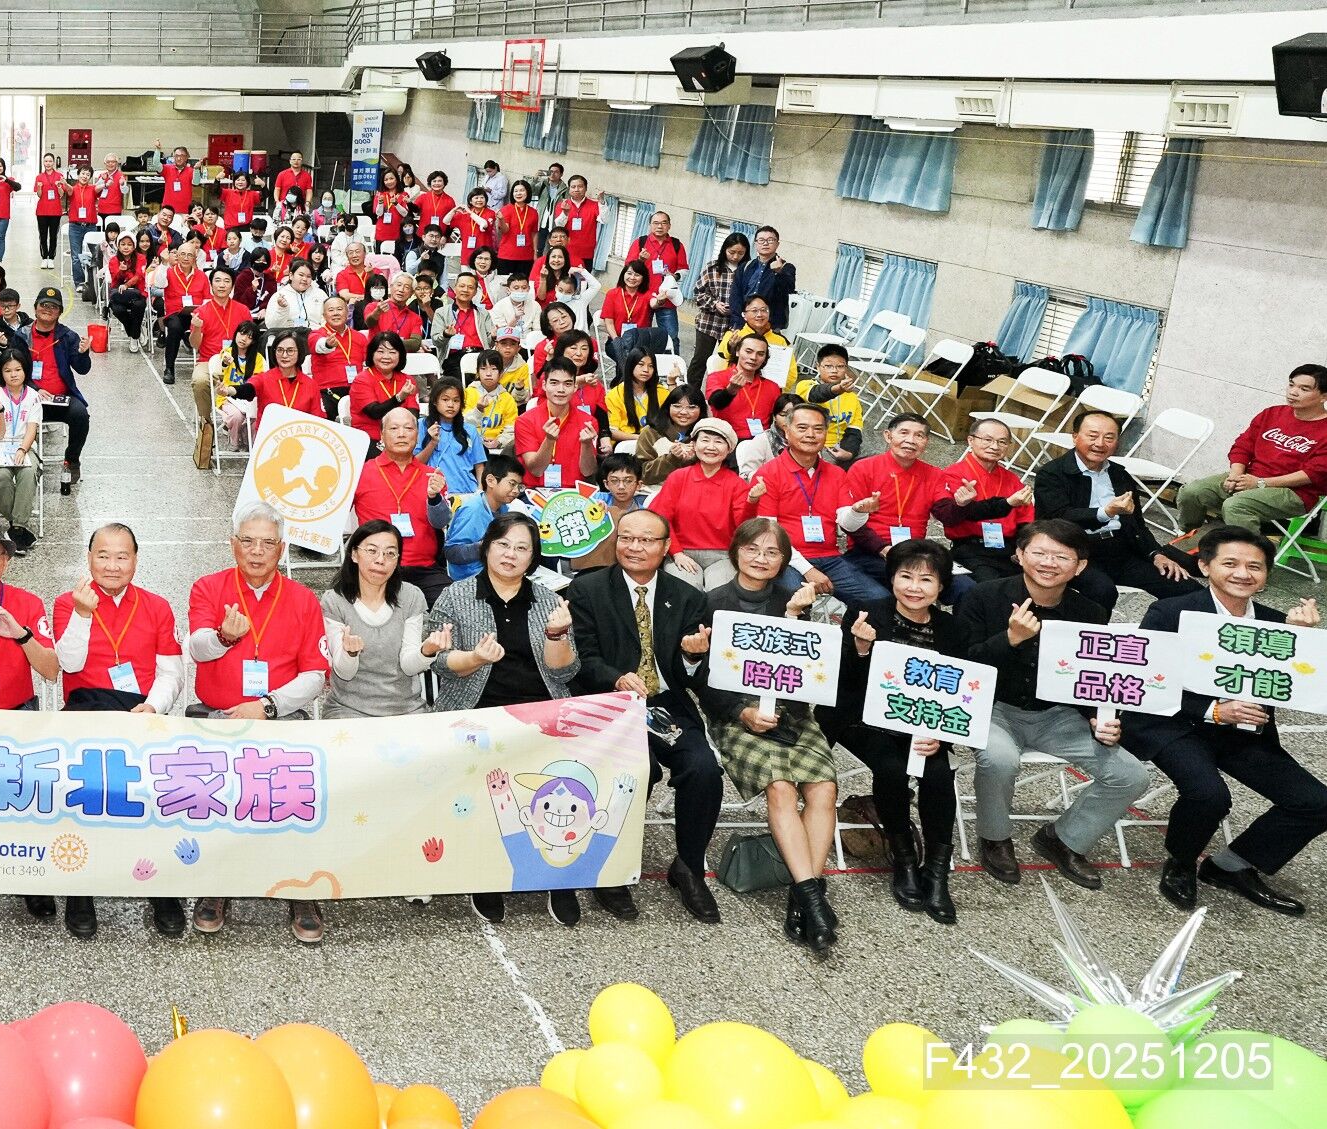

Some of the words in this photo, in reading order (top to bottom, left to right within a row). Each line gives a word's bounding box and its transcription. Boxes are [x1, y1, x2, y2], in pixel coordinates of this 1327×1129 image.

[273, 425, 320, 444] ROTARY
[322, 431, 348, 463] D3490
[287, 526, 333, 547] 新北家族
[732, 623, 822, 660] 家族式
[1076, 630, 1150, 666] 正直
[1217, 622, 1297, 661] 領導
[742, 660, 803, 694] 陪伴
[904, 656, 964, 695] 教育
[1073, 670, 1147, 706] 品格
[1214, 664, 1293, 702] 才能
[884, 692, 973, 737] 支持金
[18, 865, 46, 877] 3490
